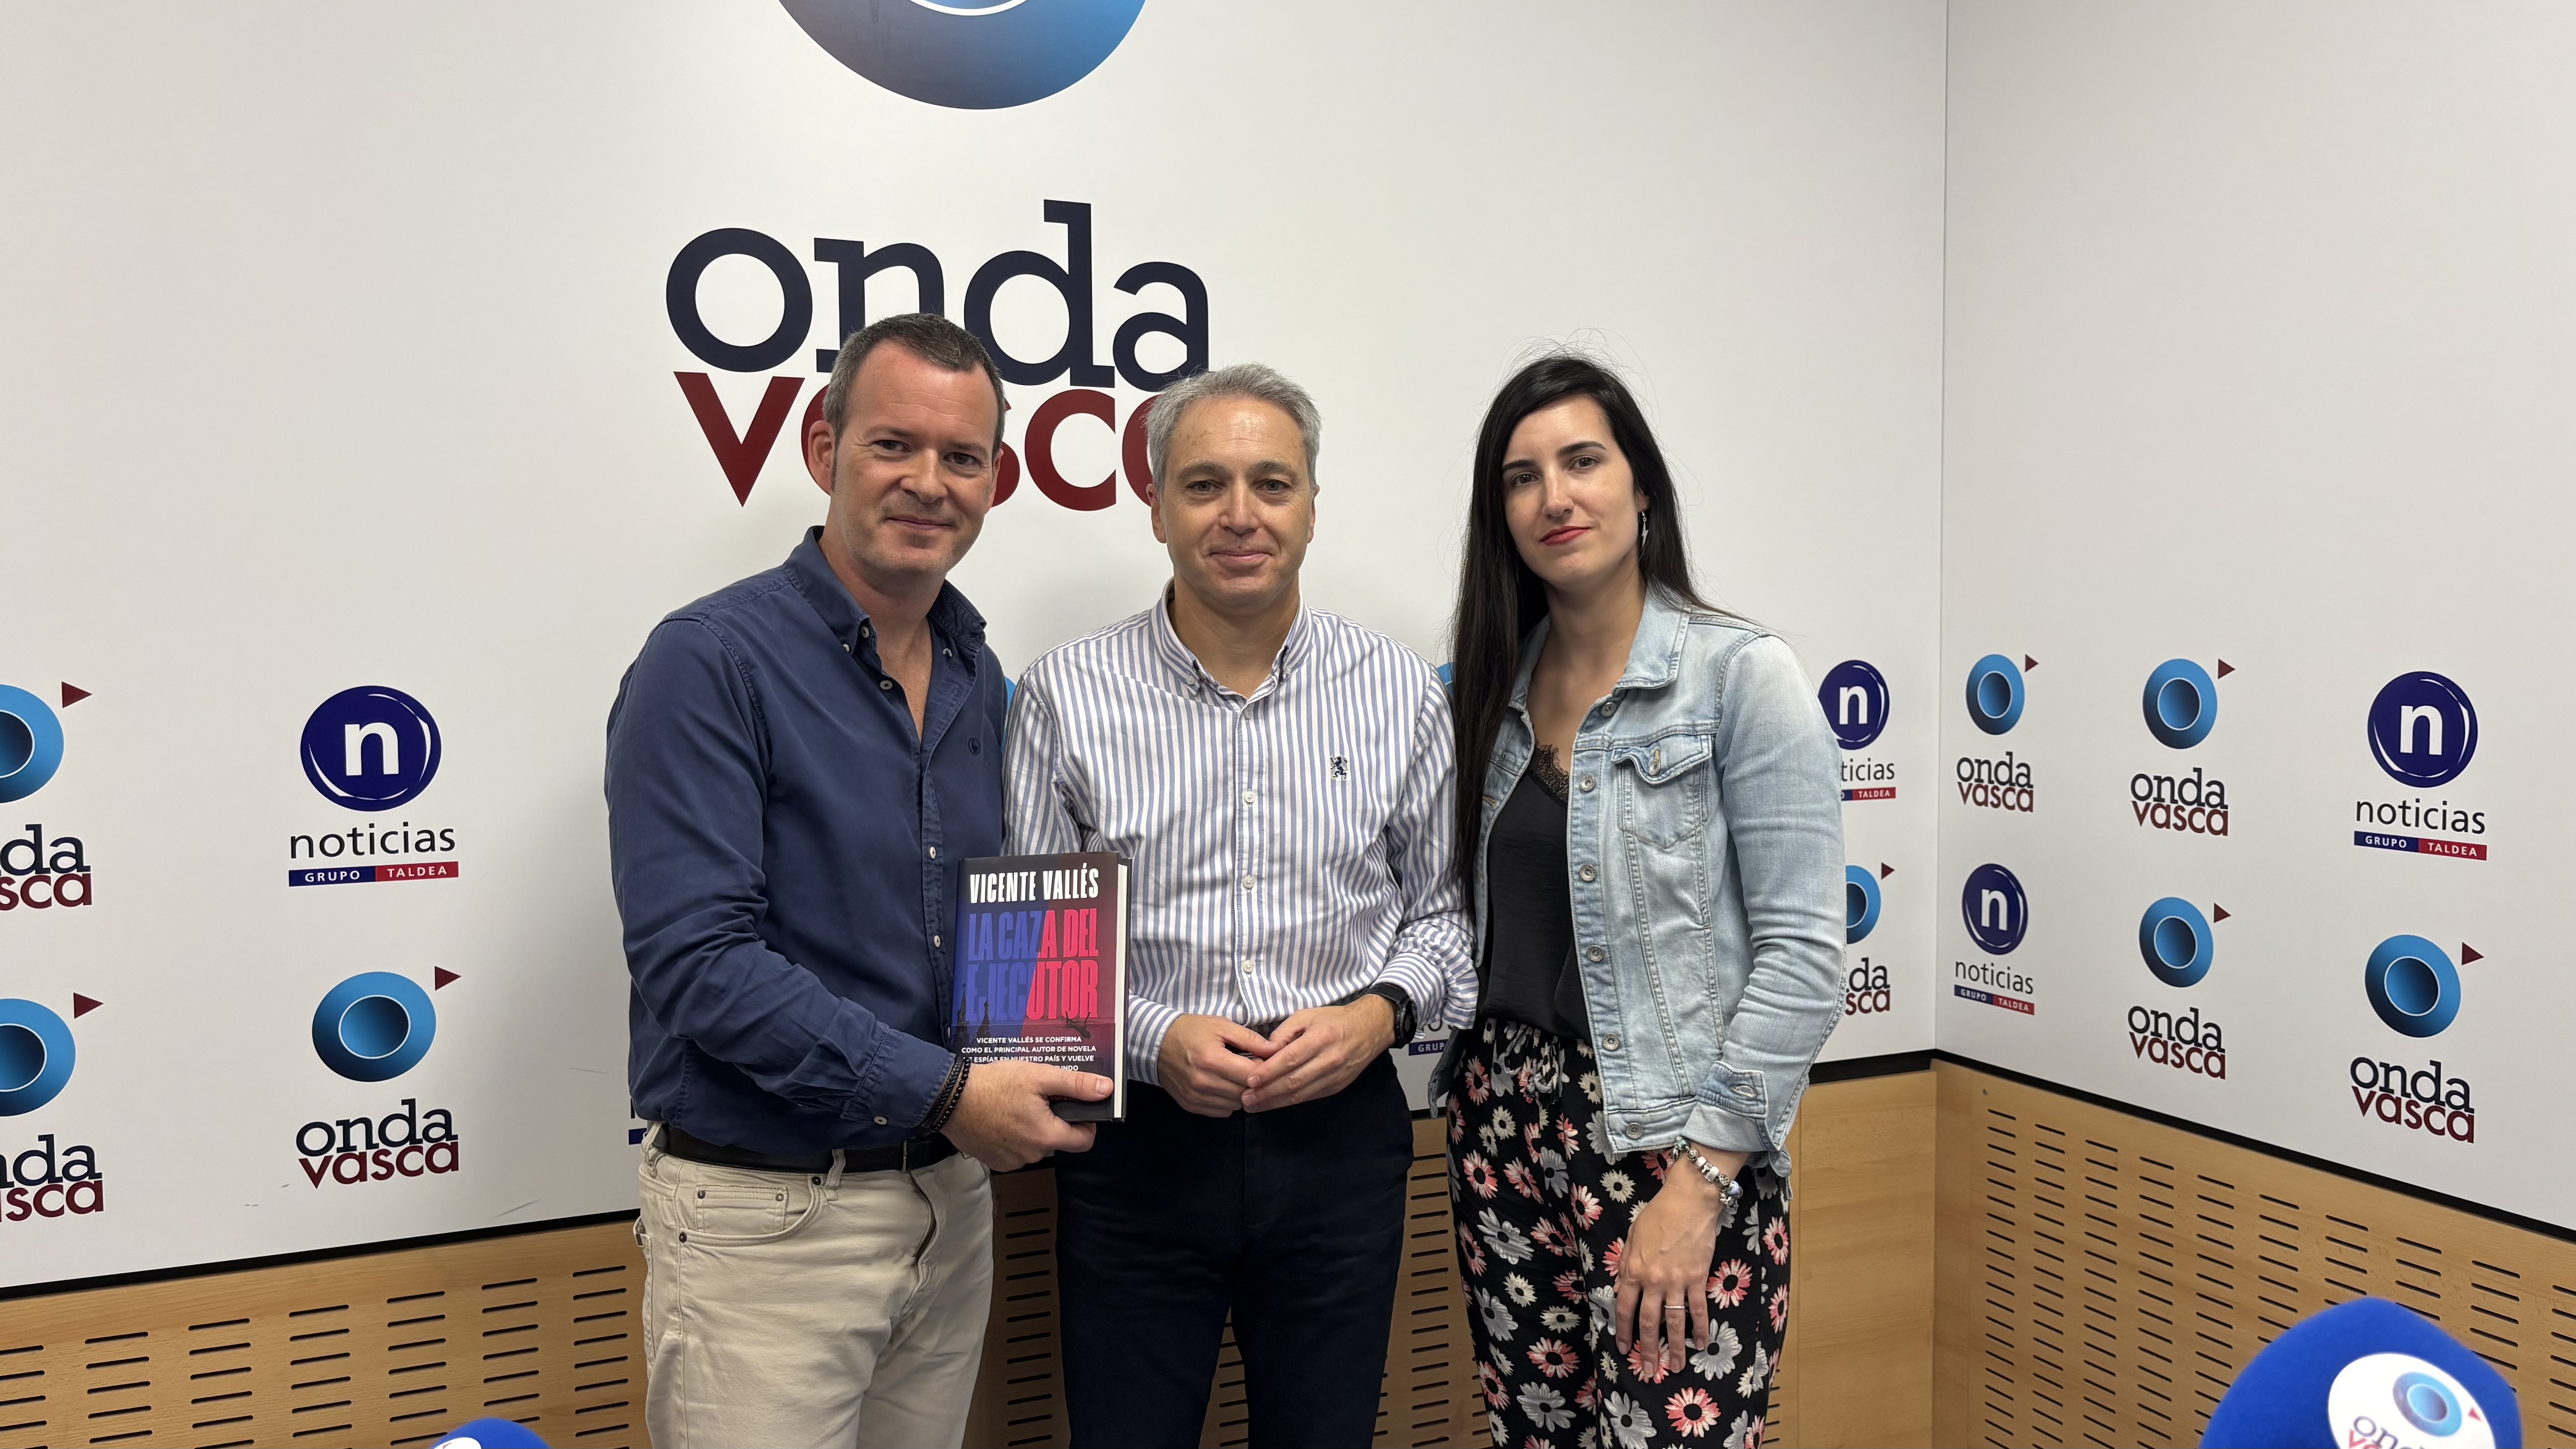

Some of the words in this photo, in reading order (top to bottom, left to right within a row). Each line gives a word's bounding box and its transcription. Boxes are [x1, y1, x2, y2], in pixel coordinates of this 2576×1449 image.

[666, 199, 1209, 392] onda
[344, 720, 399, 776] n
[2400, 705, 2442, 755] n
[1841, 758, 1895, 782] ticias
[1957, 751, 2033, 788] onda
[2131, 767, 2228, 810] onda
[1858, 790, 1890, 798] TALDEA
[1957, 782, 2033, 812] vasca
[2131, 800, 2228, 837] vasca
[2356, 798, 2485, 834] noticias
[0, 823, 91, 876] da
[291, 822, 455, 859] noticias
[2365, 836, 2407, 848] GRUPO
[2428, 842, 2477, 856] TALDEA
[0, 873, 92, 911] sca
[305, 870, 360, 883] GRUPO
[387, 866, 447, 878] TALDEA
[971, 871, 1036, 903] VICENTE
[1043, 863, 1099, 900] VALLÉS
[968, 913, 993, 961] LA
[998, 910, 1057, 960] CAZA
[1063, 908, 1099, 957] DEL
[966, 960, 1098, 1021] EJECUTOR
[1846, 957, 1890, 993] da
[1955, 961, 2033, 994] noticias
[1845, 989, 1890, 1015] sca
[1961, 989, 1987, 1001] GRUPO
[1998, 998, 2029, 1012] TALDEA
[1418, 1042, 1445, 1052] GRUP
[2128, 1006, 2225, 1053] onda
[2129, 1031, 2226, 1080] vasca
[2351, 1057, 2475, 1114] onda
[296, 1098, 459, 1157] onda
[2351, 1086, 2475, 1144] vasca
[0, 1134, 102, 1189] da
[298, 1141, 459, 1189] vasca
[0, 1180, 104, 1222] sca
